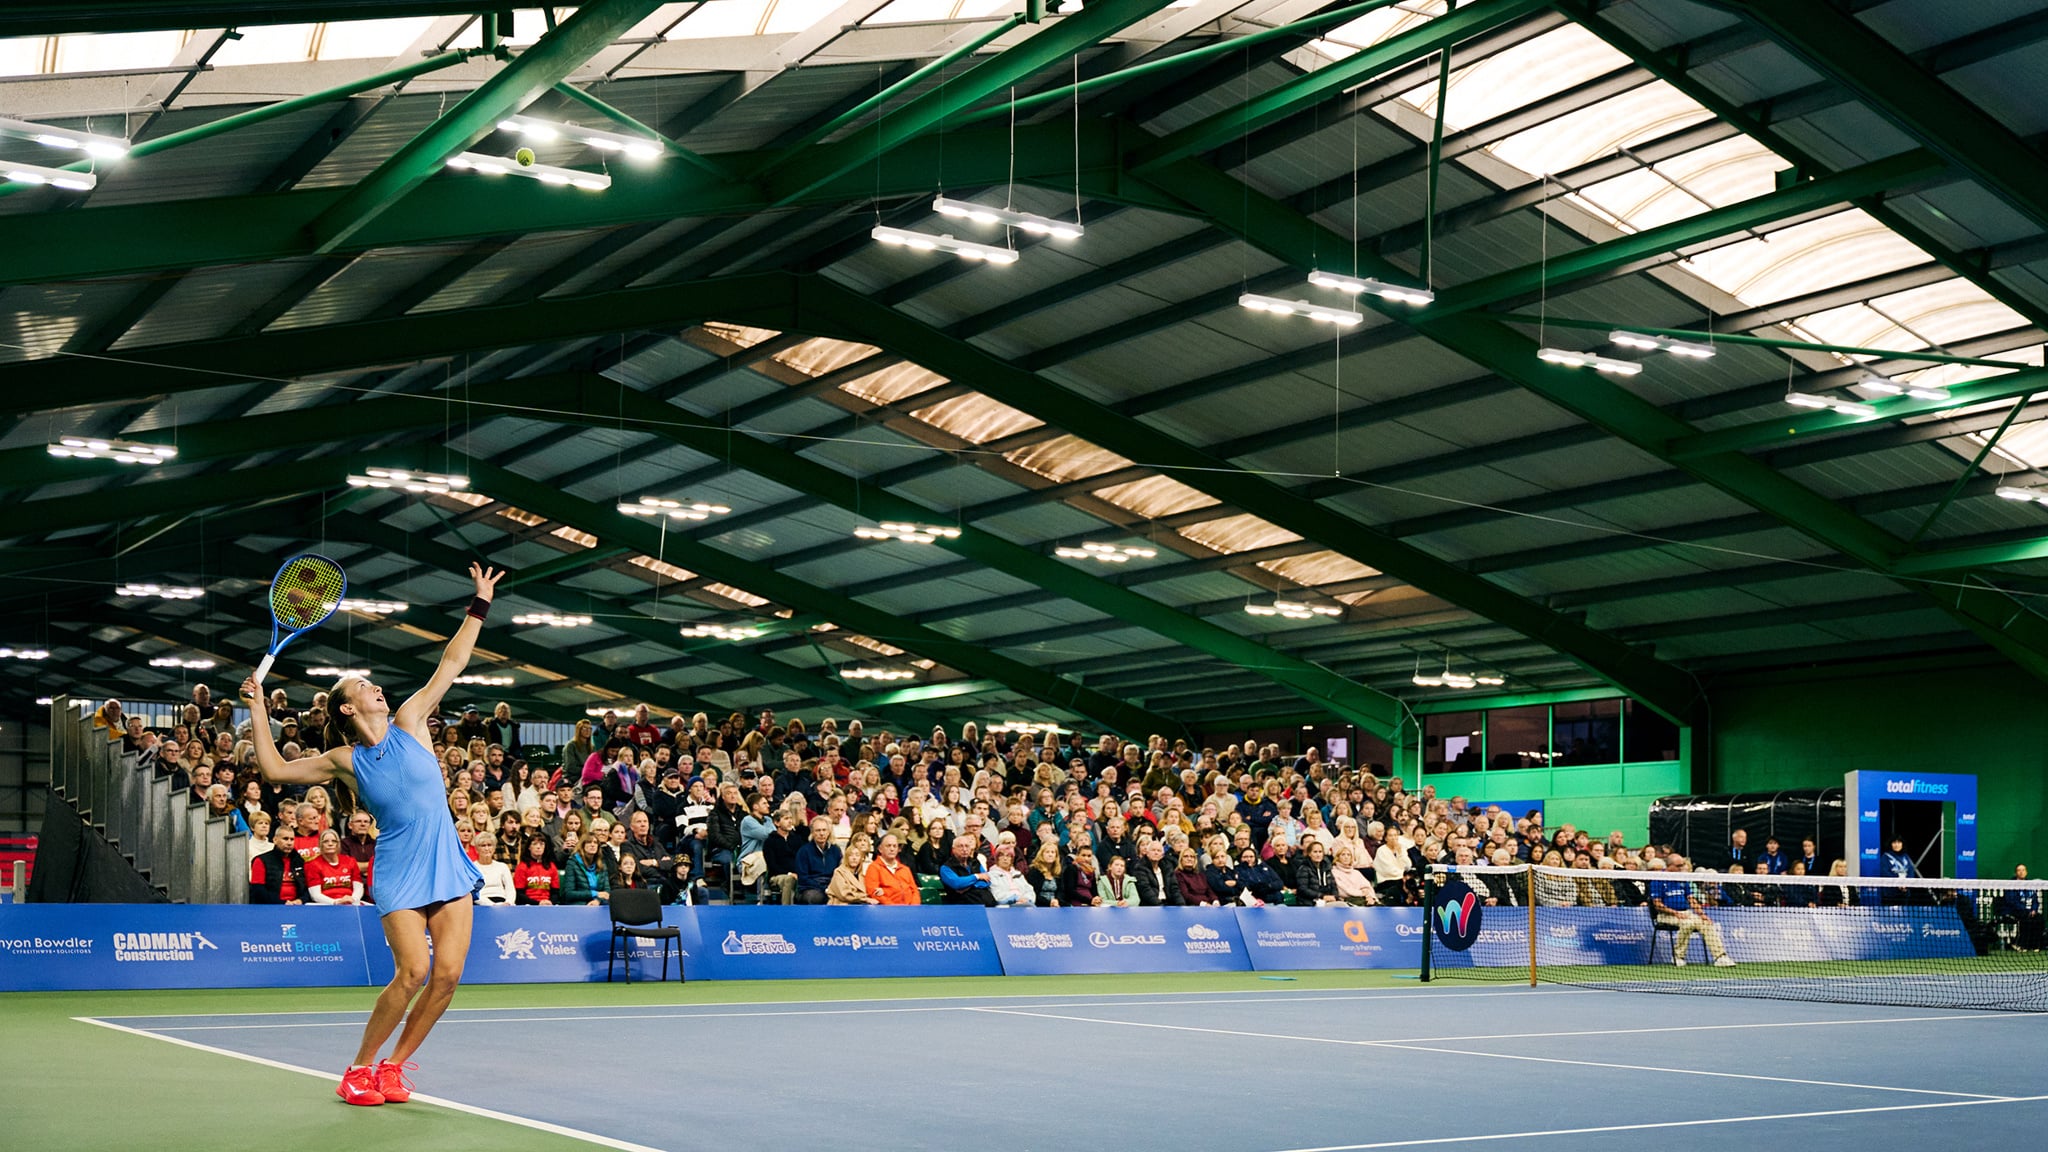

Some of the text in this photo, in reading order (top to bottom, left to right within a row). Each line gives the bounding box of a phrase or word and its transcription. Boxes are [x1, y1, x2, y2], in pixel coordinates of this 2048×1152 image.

[538, 931, 579, 945] Cymru
[921, 926, 964, 938] HOTEL
[34, 937, 94, 948] Bowdler
[113, 932, 193, 950] CADMAN
[912, 940, 980, 952] WREXHAM
[1110, 935, 1167, 945] LEXUS
[1184, 941, 1231, 951] WREXHAM
[241, 941, 341, 955] Bennett Briegal
[540, 943, 577, 955] Wales
[744, 941, 795, 953] Festivals
[115, 949, 194, 962] Construction
